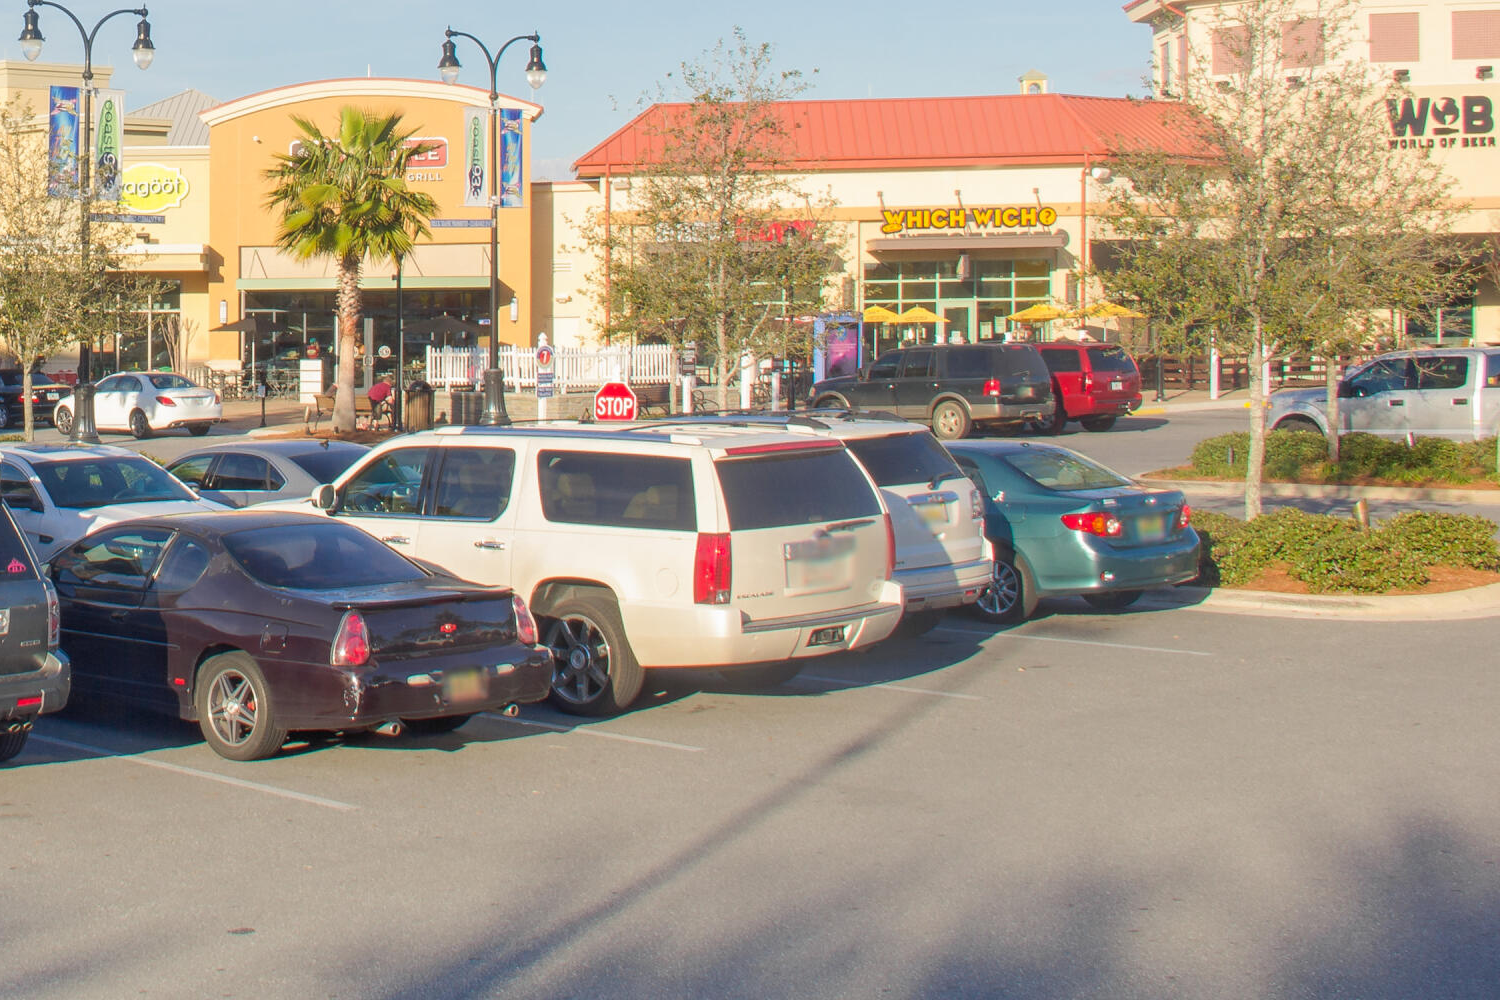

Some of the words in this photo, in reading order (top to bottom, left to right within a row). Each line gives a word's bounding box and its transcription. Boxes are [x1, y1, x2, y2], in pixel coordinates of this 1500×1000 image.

[1388, 139, 1435, 150] WORLD
[1439, 138, 1457, 149] OF
[1461, 137, 1496, 148] BEER
[407, 172, 443, 182] GRILL
[122, 178, 181, 198] agööt
[883, 208, 967, 230] WHICH
[596, 396, 633, 417] STOP
